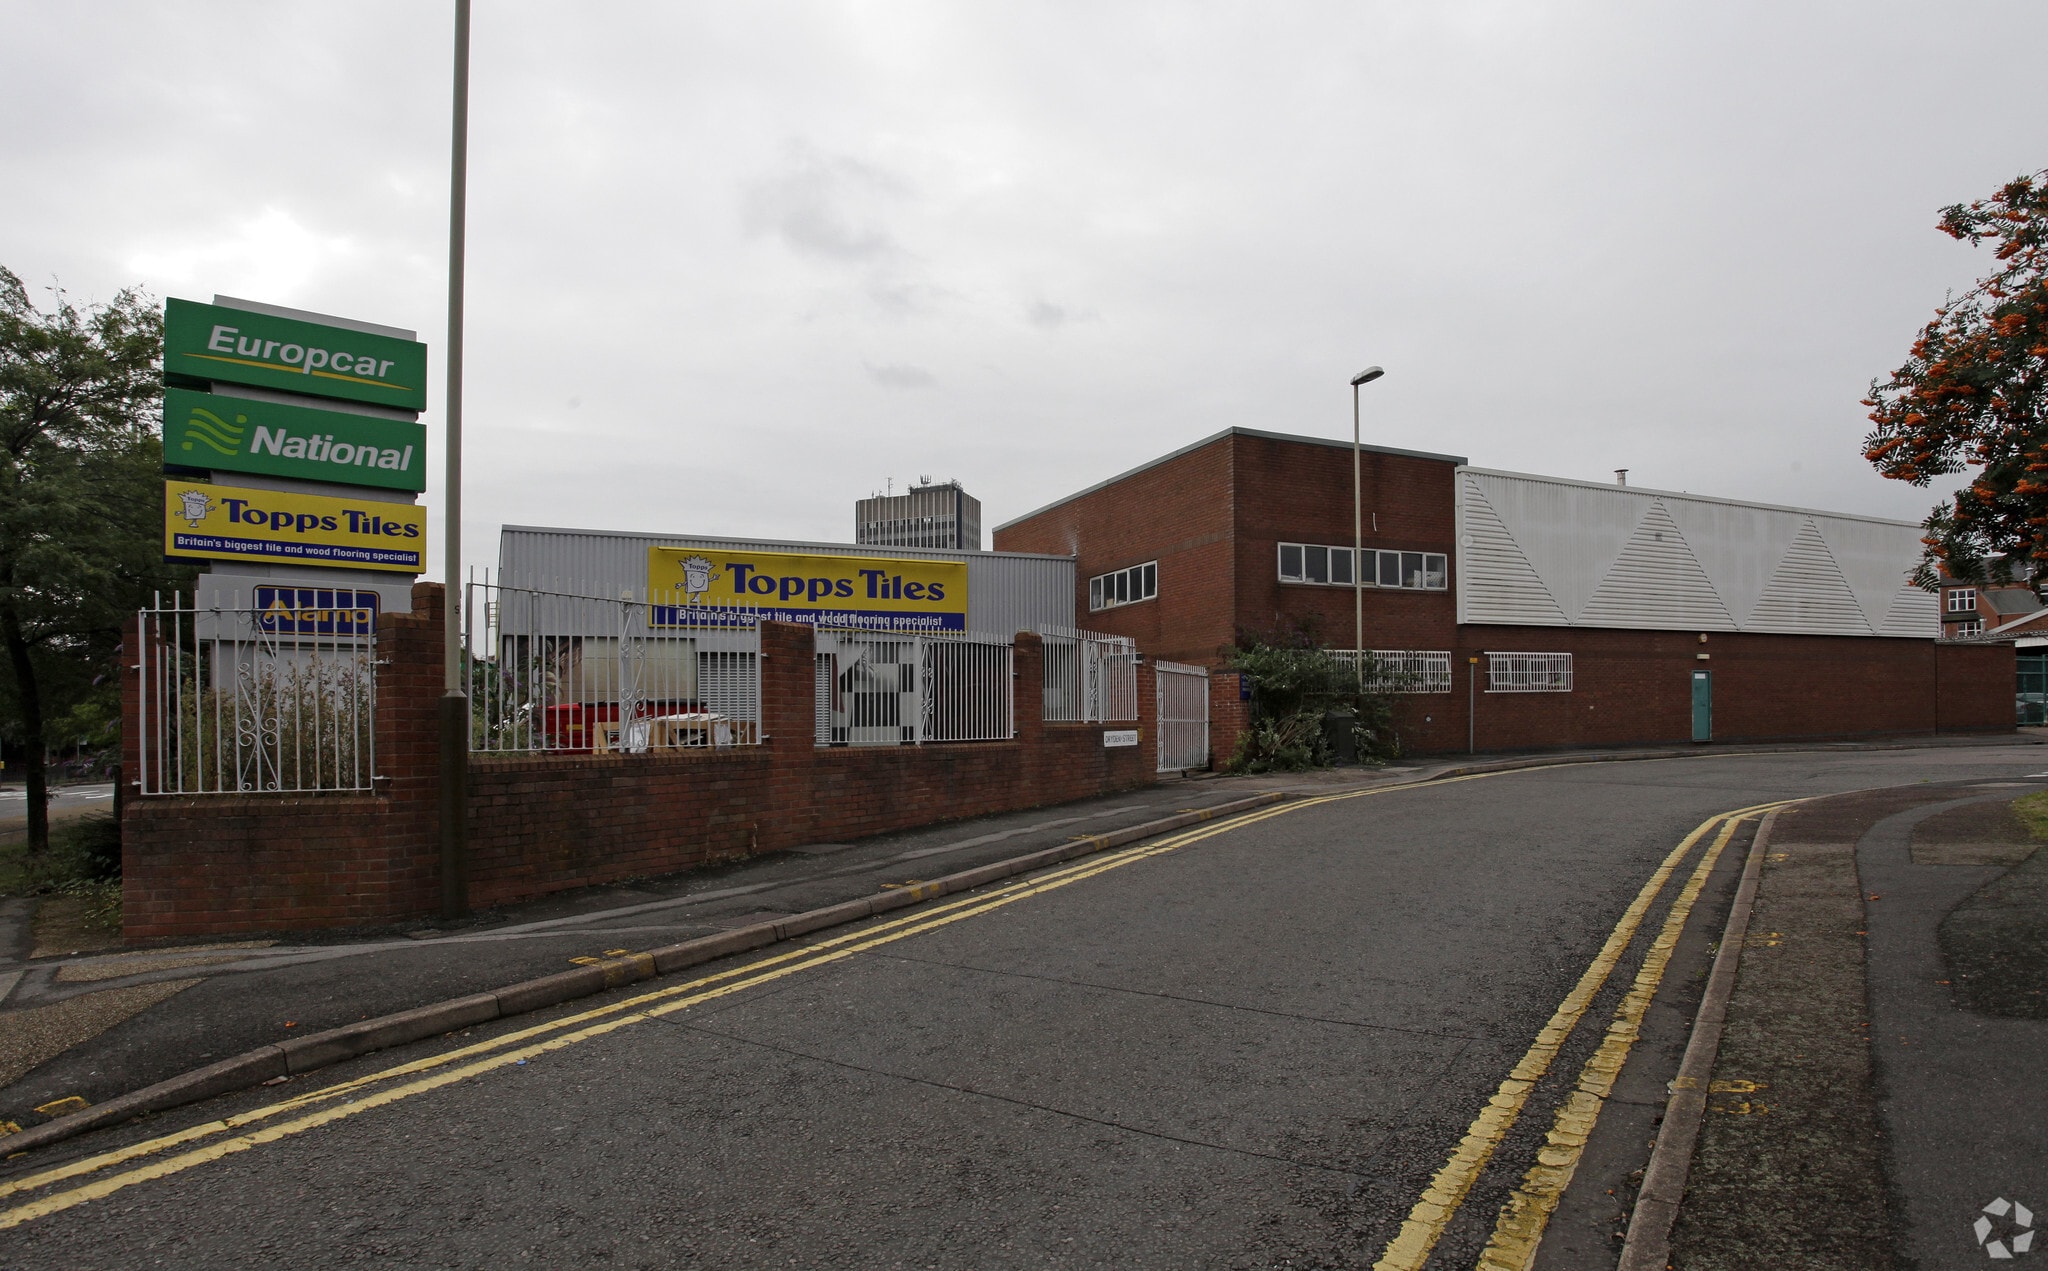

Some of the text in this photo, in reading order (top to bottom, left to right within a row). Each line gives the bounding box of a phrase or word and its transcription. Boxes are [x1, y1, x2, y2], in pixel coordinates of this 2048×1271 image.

[207, 325, 395, 378] Europcar
[250, 426, 413, 471] National
[221, 498, 419, 538] Topps Tiles
[178, 536, 417, 562] Britain's biggest tile and wood flooring specialist
[725, 563, 945, 602] Topps Tiles
[264, 599, 370, 624] Alamo
[679, 609, 726, 621] Bitans
[730, 610, 772, 623] bggst
[774, 611, 792, 623] tile
[795, 612, 816, 623] and
[894, 615, 942, 627] specialist
